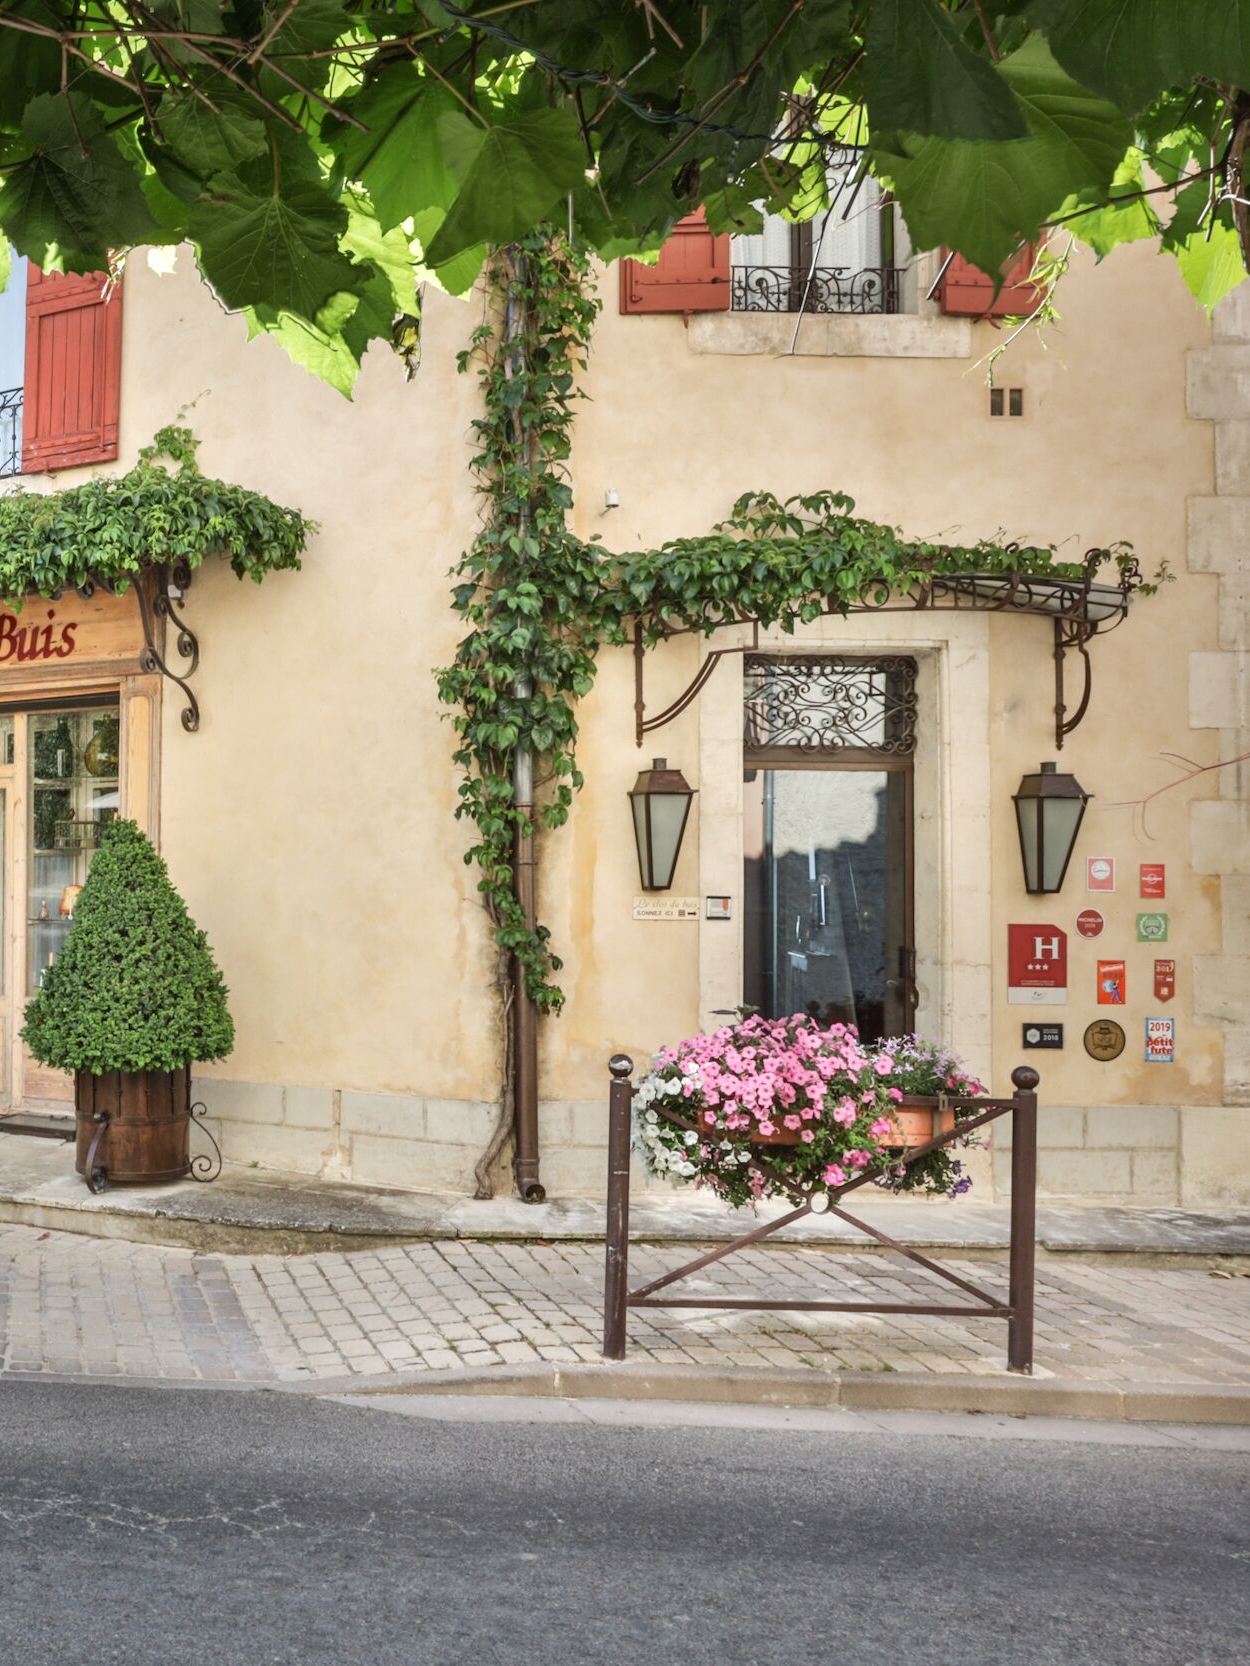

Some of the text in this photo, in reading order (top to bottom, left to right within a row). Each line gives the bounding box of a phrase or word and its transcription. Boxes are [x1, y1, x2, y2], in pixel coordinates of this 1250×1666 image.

[1033, 936, 1060, 960] H
[1150, 1022, 1171, 1031] 2019
[1146, 1037, 1173, 1047] petit
